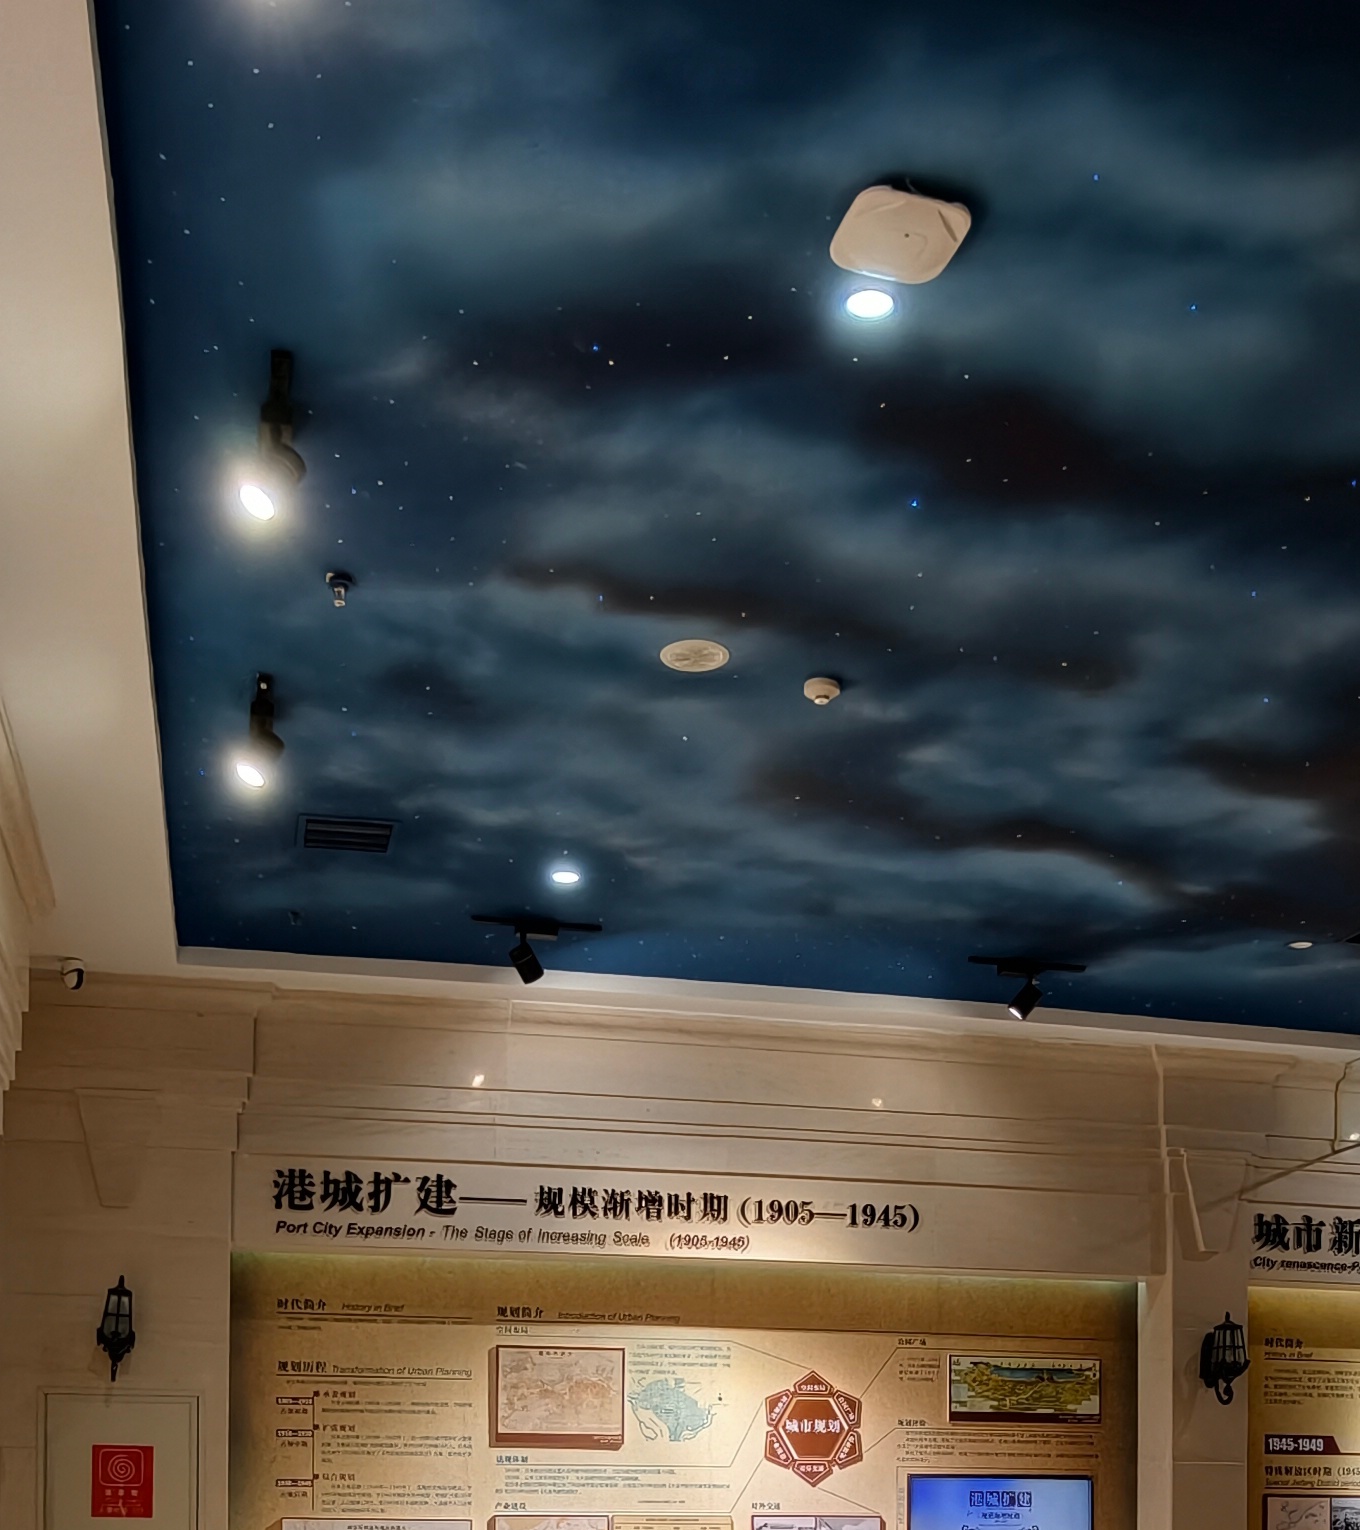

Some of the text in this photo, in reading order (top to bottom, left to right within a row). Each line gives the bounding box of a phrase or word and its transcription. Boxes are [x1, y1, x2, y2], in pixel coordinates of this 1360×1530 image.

[271, 1167, 923, 1234] 港城扩建——规模渐增时期 (1905—1945)
[274, 1220, 309, 1236] Port
[311, 1221, 343, 1239] City
[346, 1222, 426, 1242] Expansion
[443, 1224, 469, 1241] The
[474, 1225, 514, 1246] Stage
[518, 1226, 533, 1243] of
[536, 1229, 608, 1250] Increasing
[612, 1230, 652, 1248] Scale
[784, 1417, 842, 1435] 城市规划
[1267, 1437, 1325, 1453] 1945-1949
